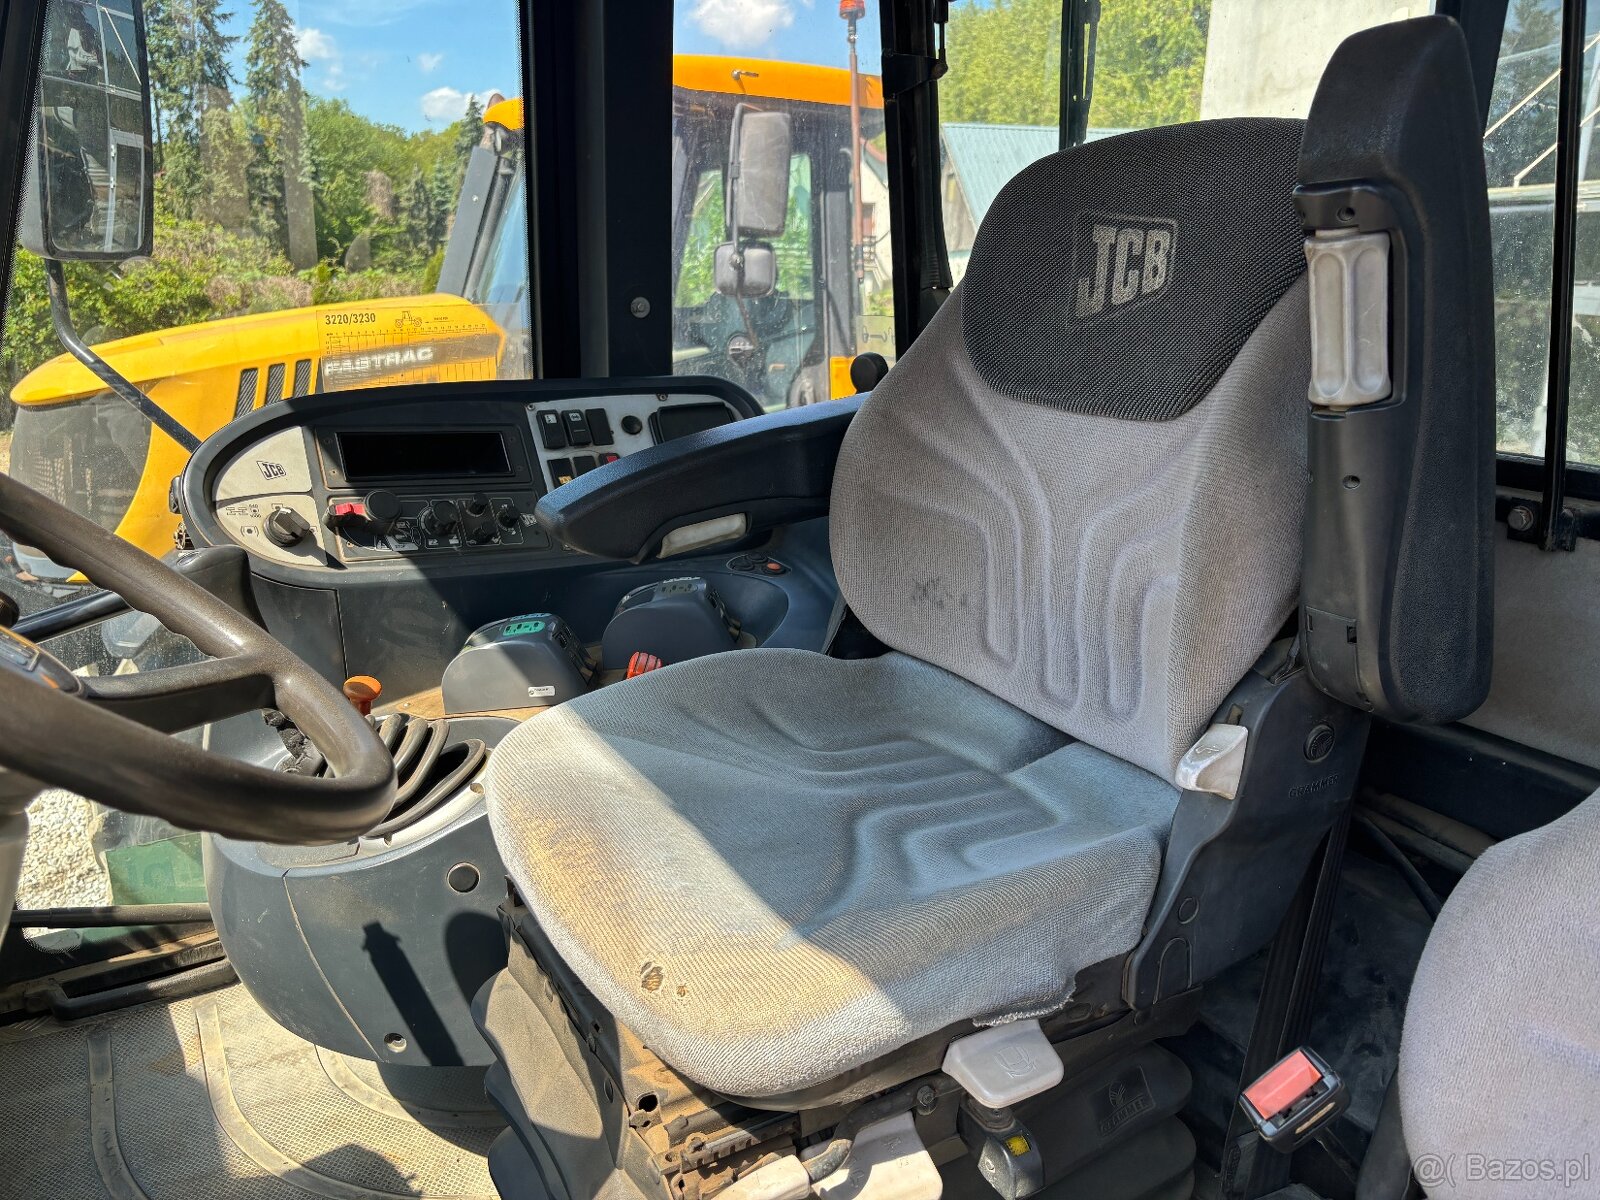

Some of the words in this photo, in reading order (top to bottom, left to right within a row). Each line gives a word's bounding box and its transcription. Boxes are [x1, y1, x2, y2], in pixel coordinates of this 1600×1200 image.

[1076, 224, 1171, 318] JCB
[325, 312, 376, 325] 3220/3230
[260, 462, 286, 479] JCB
